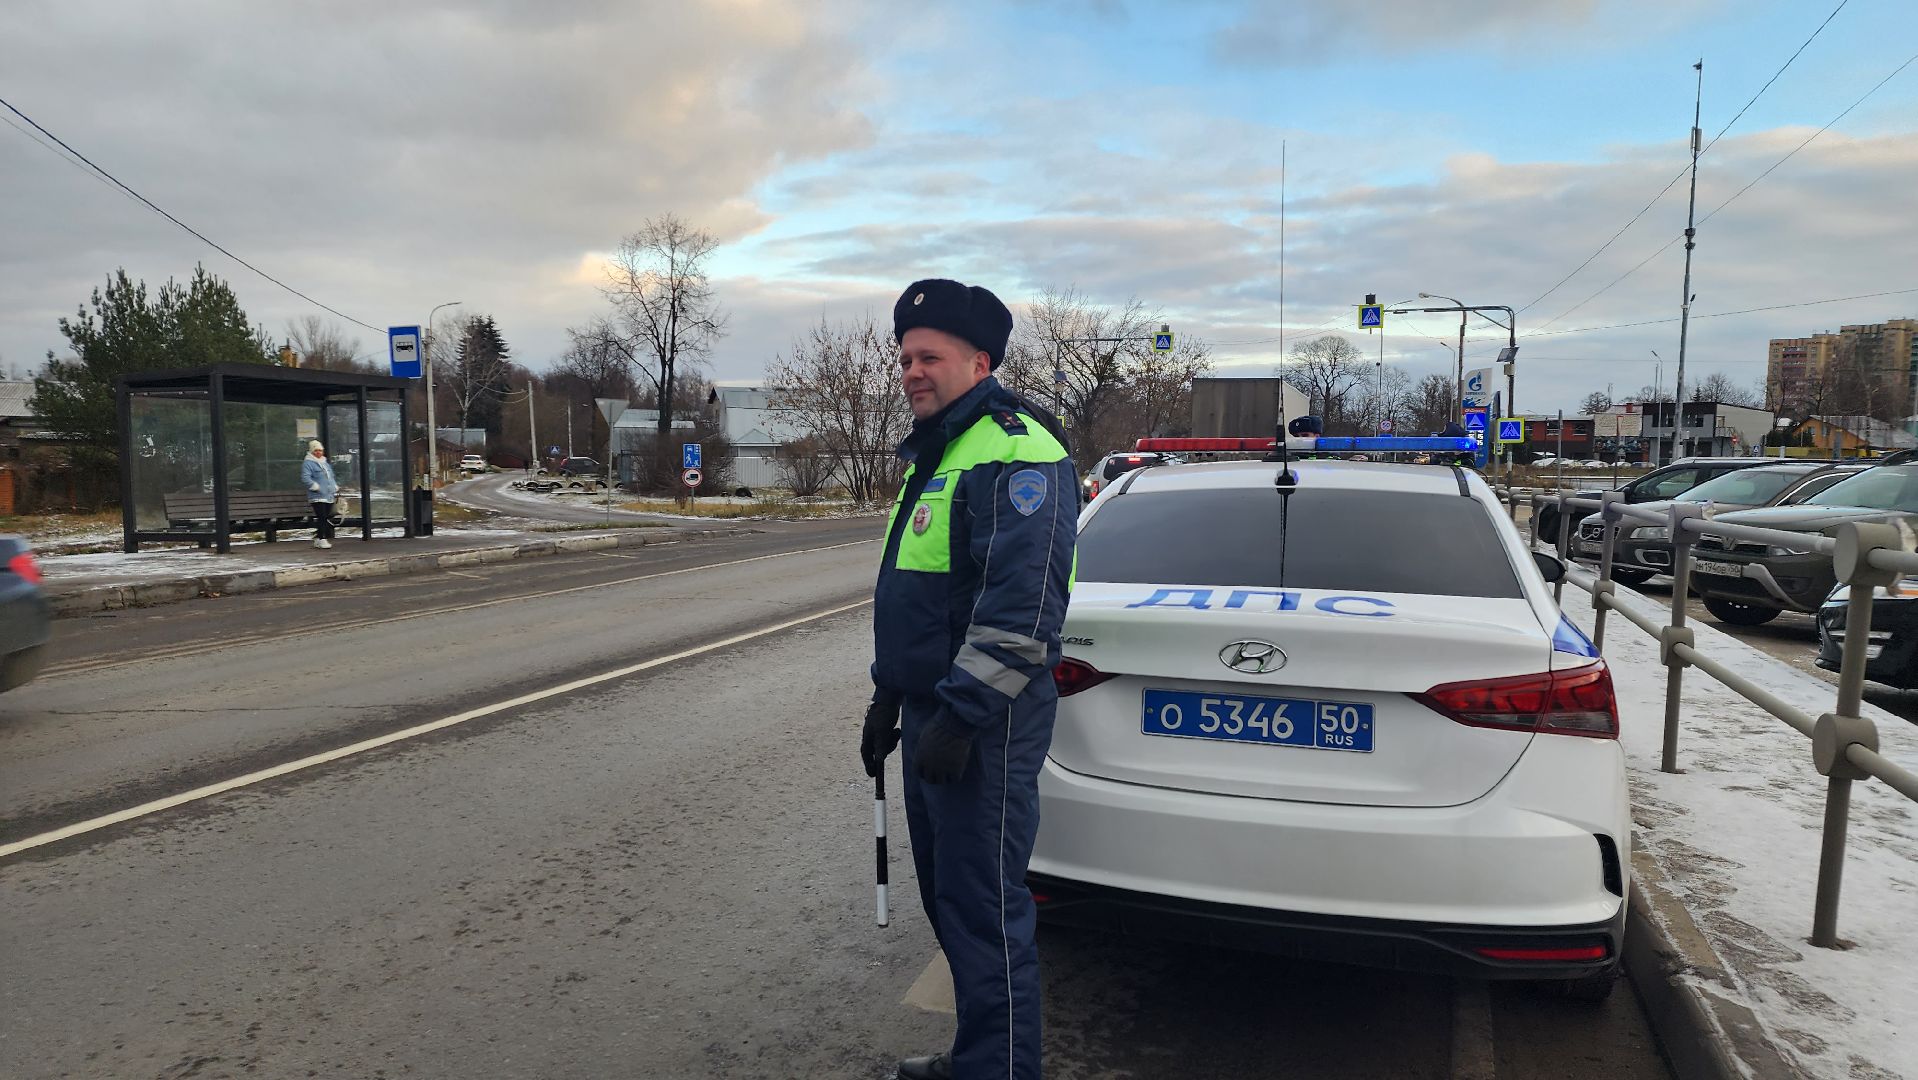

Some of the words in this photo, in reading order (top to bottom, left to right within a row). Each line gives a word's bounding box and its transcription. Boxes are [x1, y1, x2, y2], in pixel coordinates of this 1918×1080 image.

[1124, 588, 1396, 617] ДПС
[1160, 703, 1183, 730] О
[1199, 698, 1294, 739] 5346
[1320, 704, 1359, 734] 50
[1325, 734, 1354, 746] RUS
